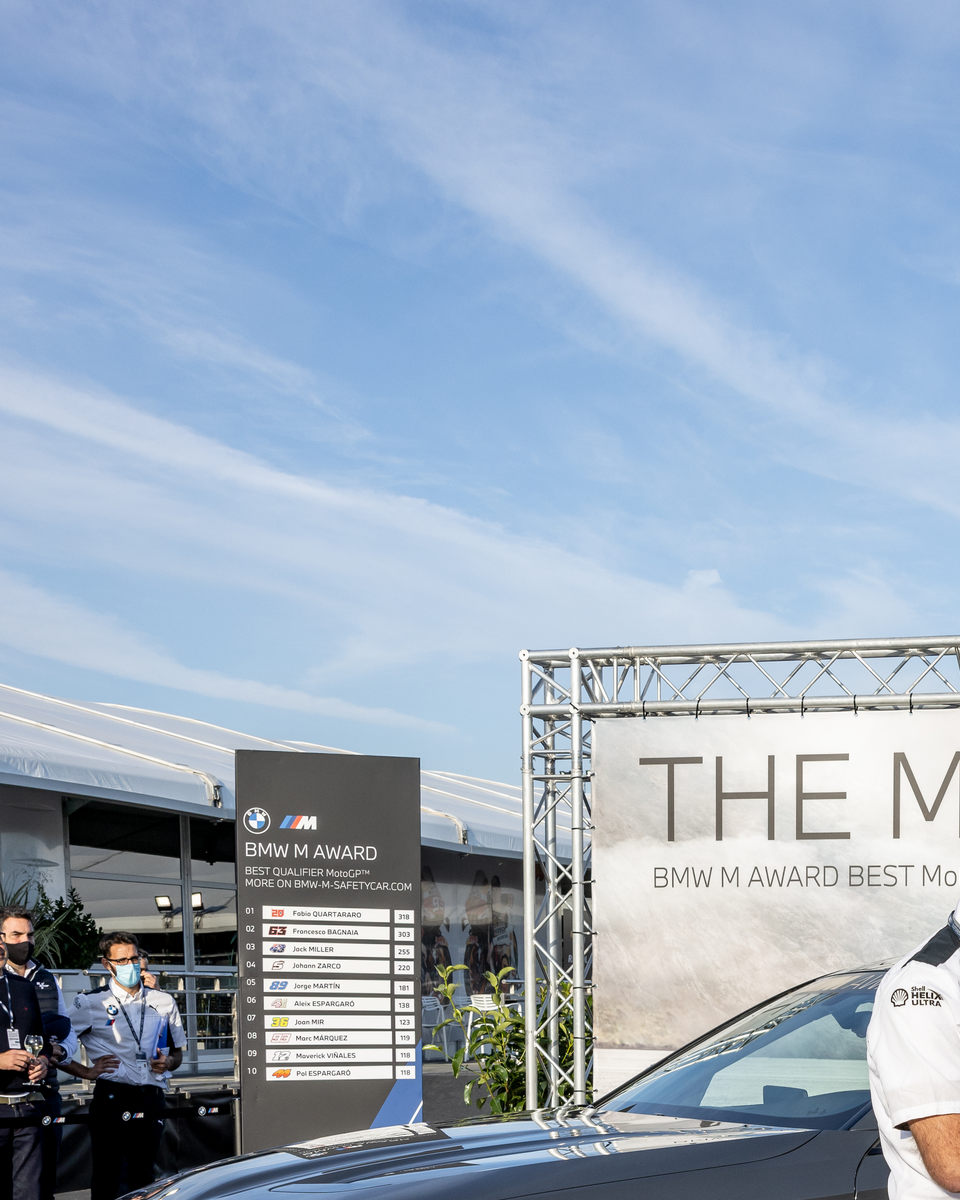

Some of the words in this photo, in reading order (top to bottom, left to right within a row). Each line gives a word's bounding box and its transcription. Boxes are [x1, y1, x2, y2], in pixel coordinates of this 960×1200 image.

[639, 753, 851, 841] THE
[245, 842, 289, 858] BMW
[294, 844, 309, 859] M
[314, 844, 377, 861] AWARD
[245, 867, 270, 876] BEST
[273, 867, 324, 877] QUALIFIER
[654, 866, 713, 888] BMW
[721, 866, 740, 888] M
[748, 866, 839, 887] AWARD
[848, 865, 915, 887] BEST
[245, 879, 274, 888] MORE
[277, 879, 292, 888] ON
[294, 880, 412, 891] BMW-M-SAFETYCAR.COM
[293, 910, 311, 918] Fabio
[294, 983, 312, 991] Jorge
[911, 992, 943, 1000] HELIX
[271, 1017, 289, 1027] 36
